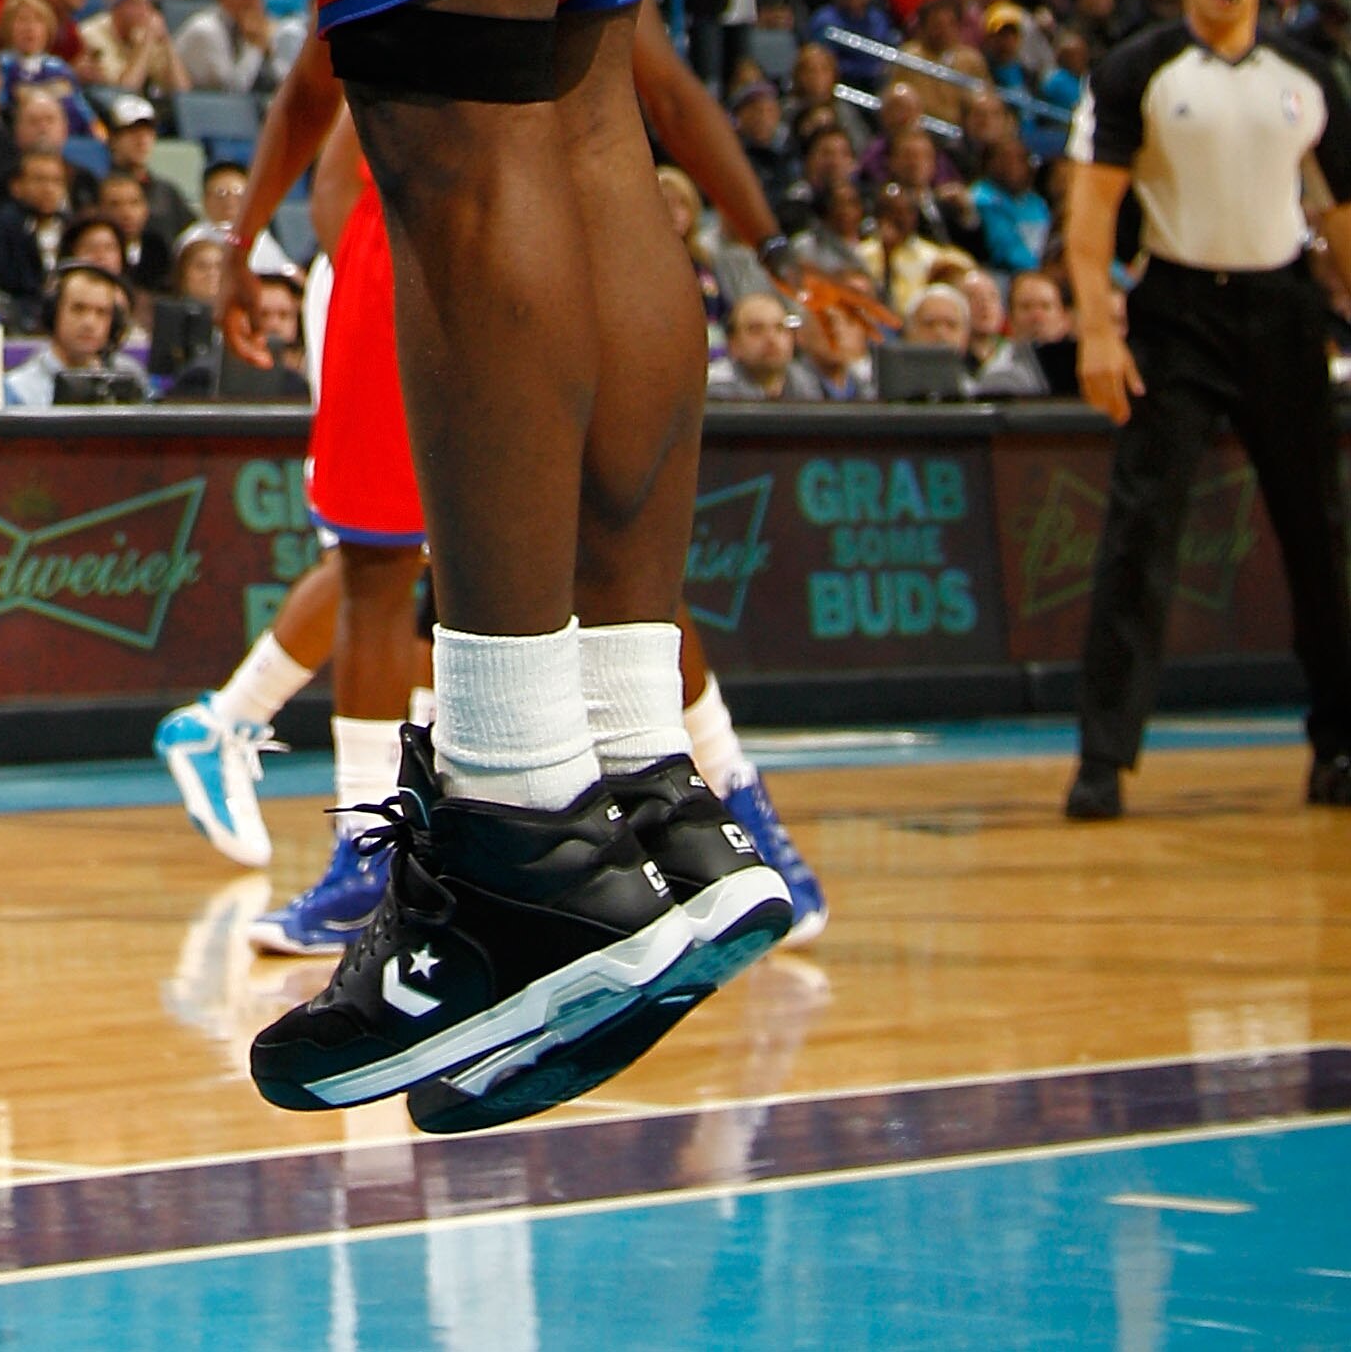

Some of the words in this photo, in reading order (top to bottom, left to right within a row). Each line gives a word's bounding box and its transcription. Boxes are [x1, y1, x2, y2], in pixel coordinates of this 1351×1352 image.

[798, 458, 966, 523] GRAB
[832, 526, 944, 567] SOME
[809, 567, 978, 638] BUDS
